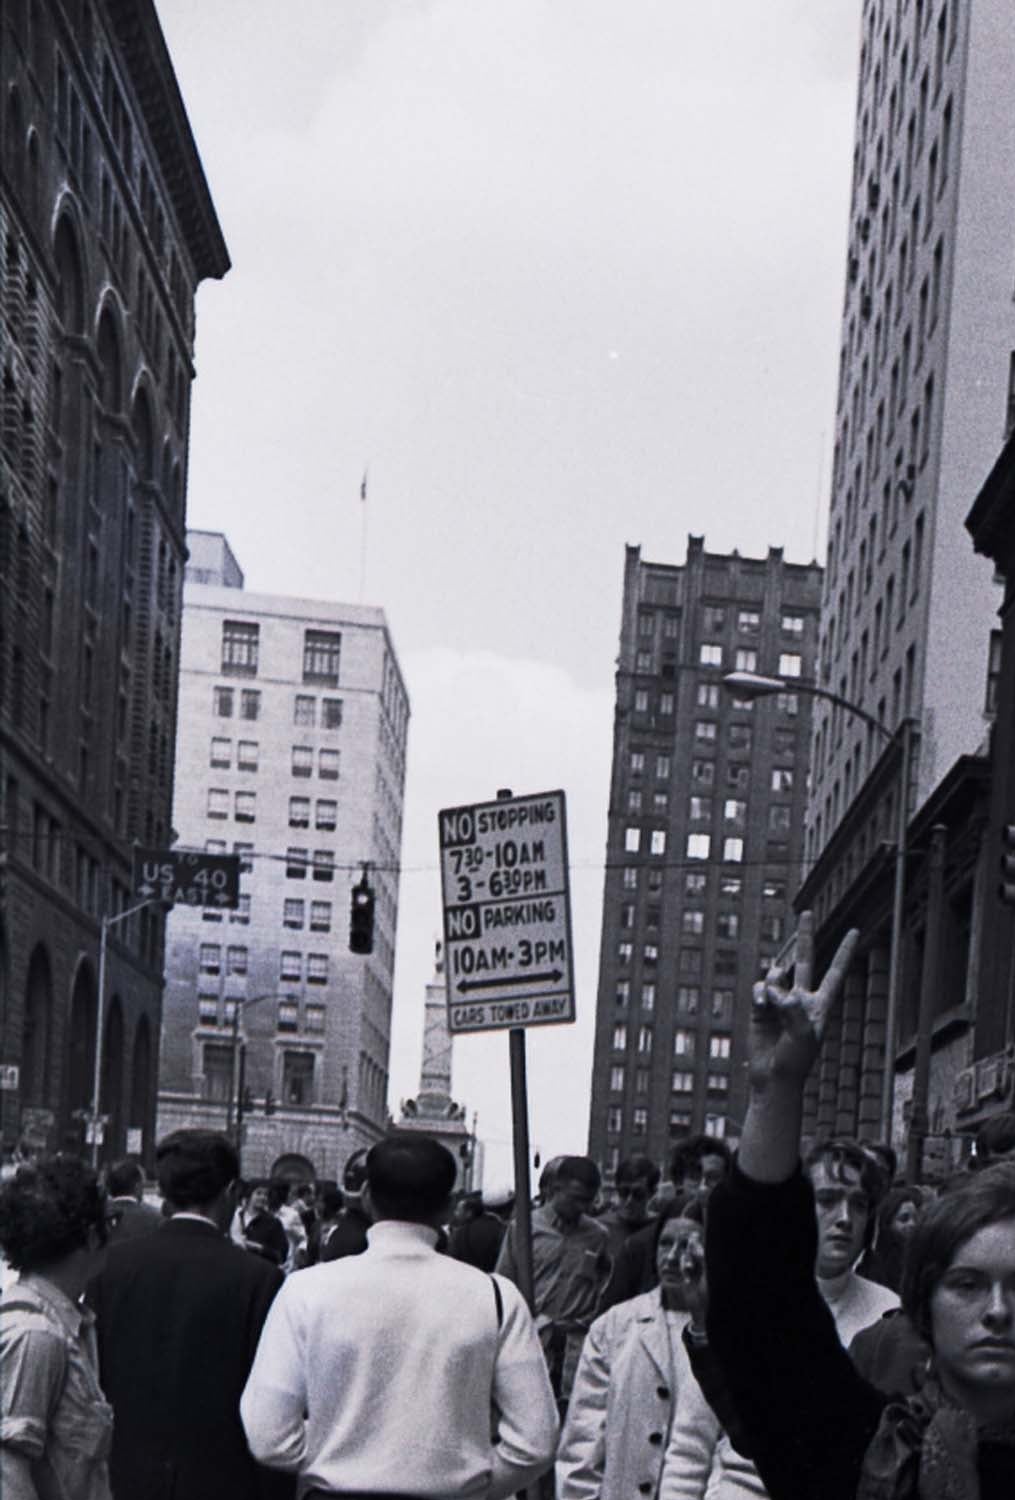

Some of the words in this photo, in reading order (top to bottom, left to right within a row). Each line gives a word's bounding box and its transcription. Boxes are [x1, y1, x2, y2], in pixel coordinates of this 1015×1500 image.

[444, 812, 473, 844] NO
[478, 802, 555, 834] STOPPING
[143, 862, 174, 884] US
[193, 868, 227, 889] 40
[161, 884, 209, 905] EAST
[447, 908, 476, 938] NO
[484, 900, 556, 930] PARKING
[454, 1004, 485, 1026] CARS
[491, 1001, 529, 1022] TOWED
[533, 997, 568, 1017] AWAY
